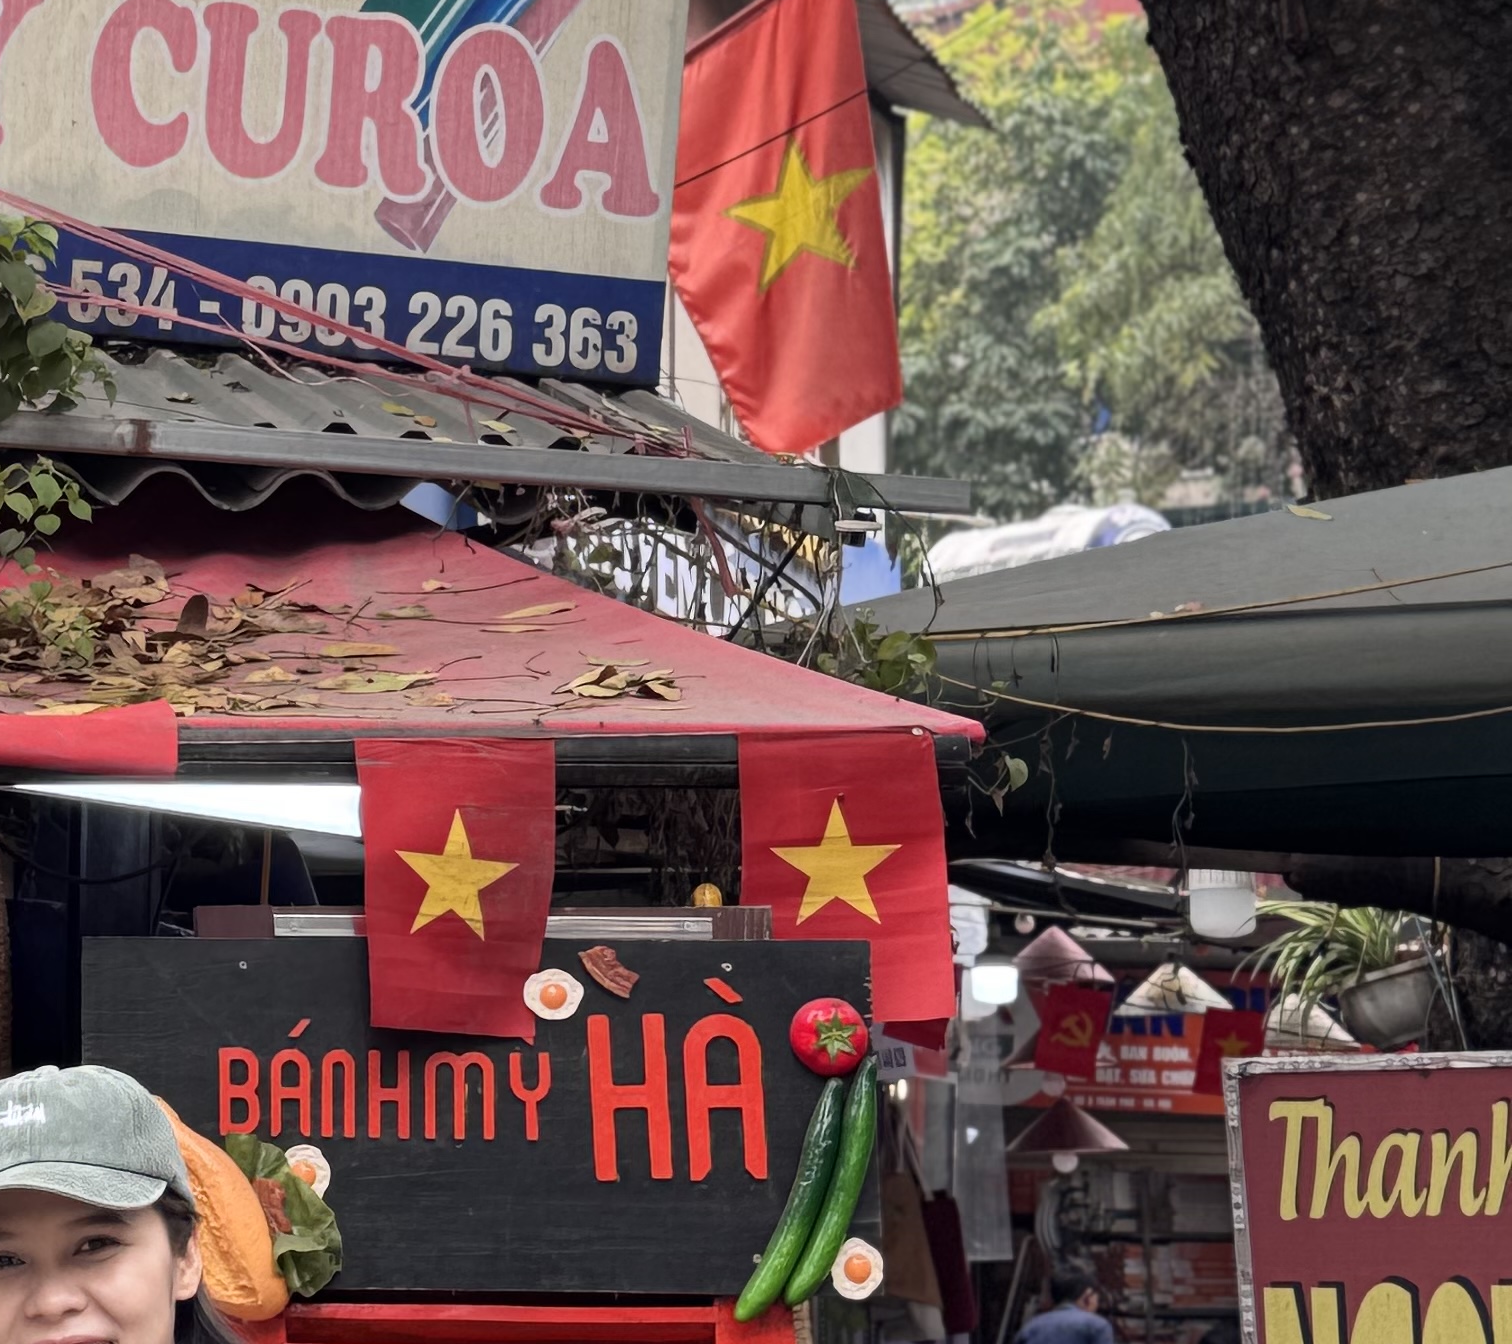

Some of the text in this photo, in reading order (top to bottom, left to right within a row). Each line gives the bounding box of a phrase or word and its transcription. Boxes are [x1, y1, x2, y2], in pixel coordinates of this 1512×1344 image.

[66, 258, 179, 330] 534
[241, 274, 387, 350] 0903
[405, 290, 514, 361] 226
[532, 302, 639, 374] 363
[587, 977, 769, 1183] HÀ
